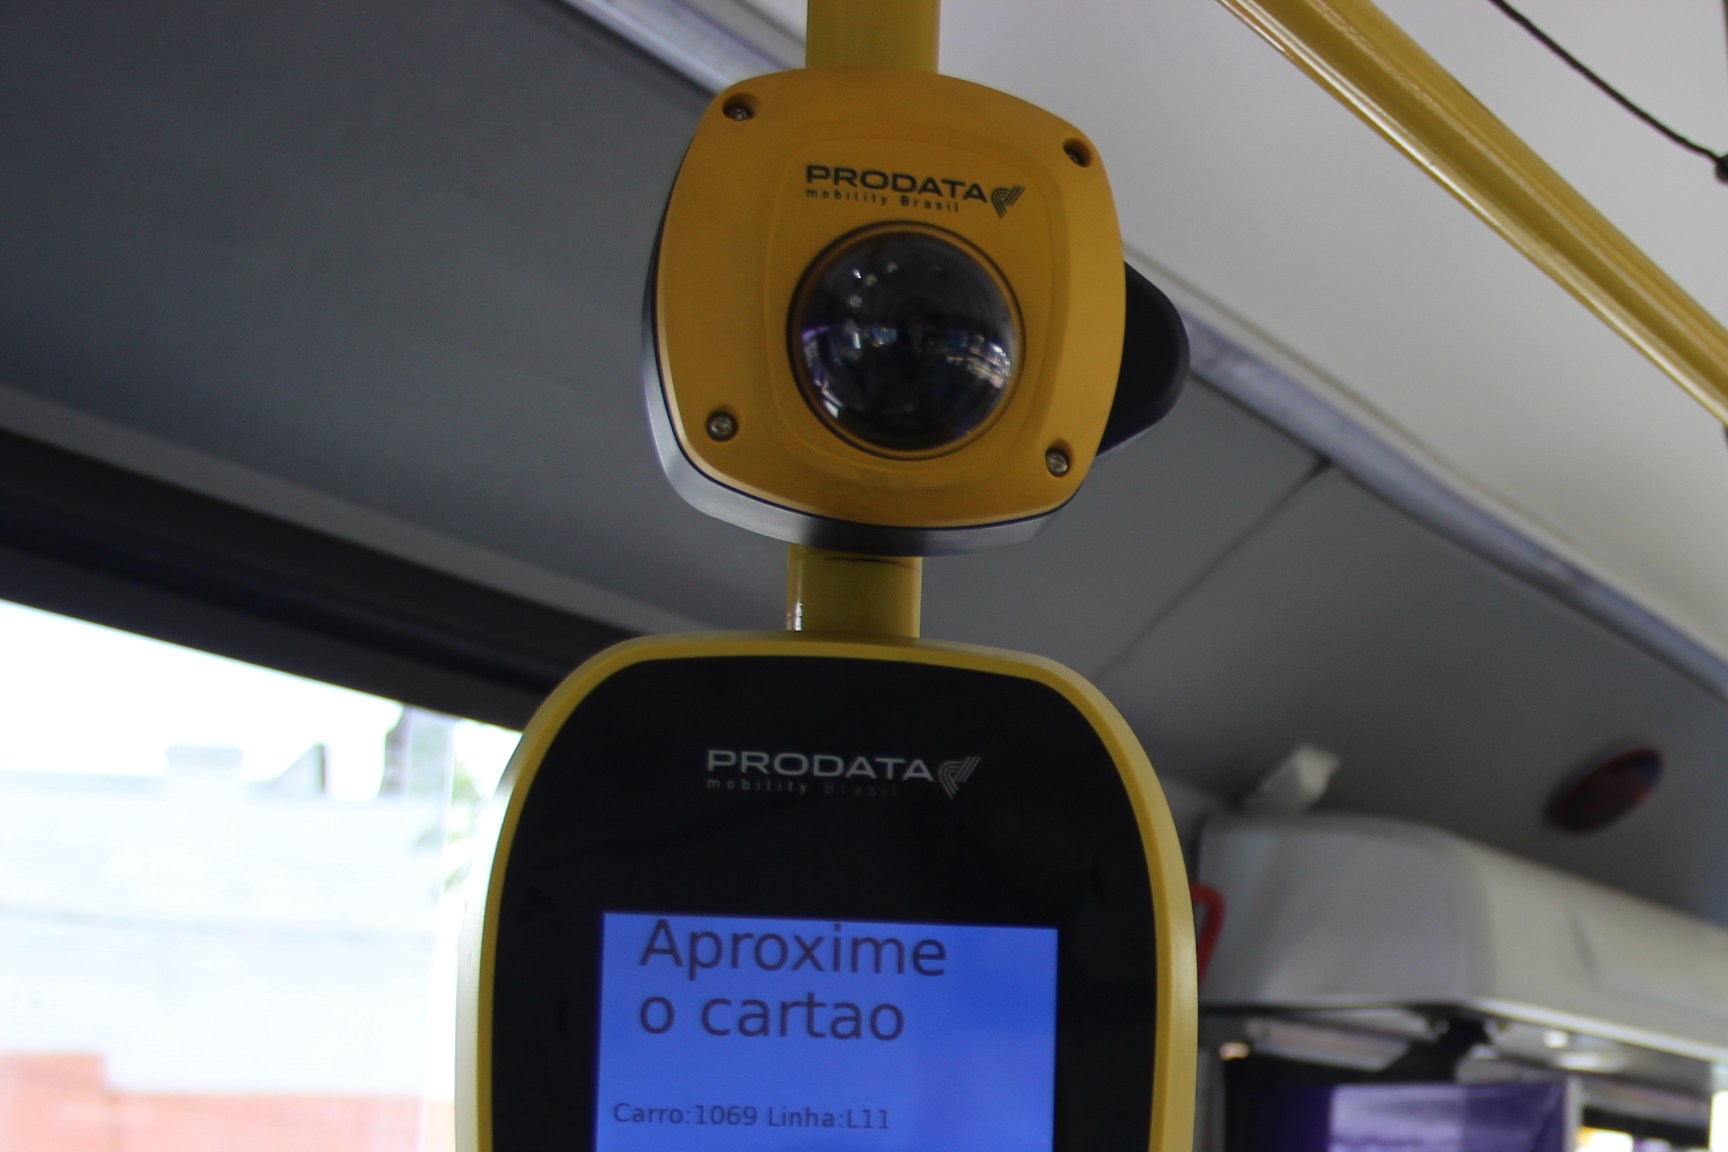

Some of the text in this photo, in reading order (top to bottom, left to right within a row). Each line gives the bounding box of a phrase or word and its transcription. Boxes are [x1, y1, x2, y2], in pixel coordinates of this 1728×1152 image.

[806, 165, 988, 204] PRODATA
[806, 188, 960, 213] mobility Brasil
[707, 749, 935, 782] PRODATA
[706, 777, 808, 796] mobility
[639, 918, 948, 982] Aproxime
[639, 992, 905, 1041] o cartao
[613, 1102, 890, 1130] Carro:1069 Linha:L11
